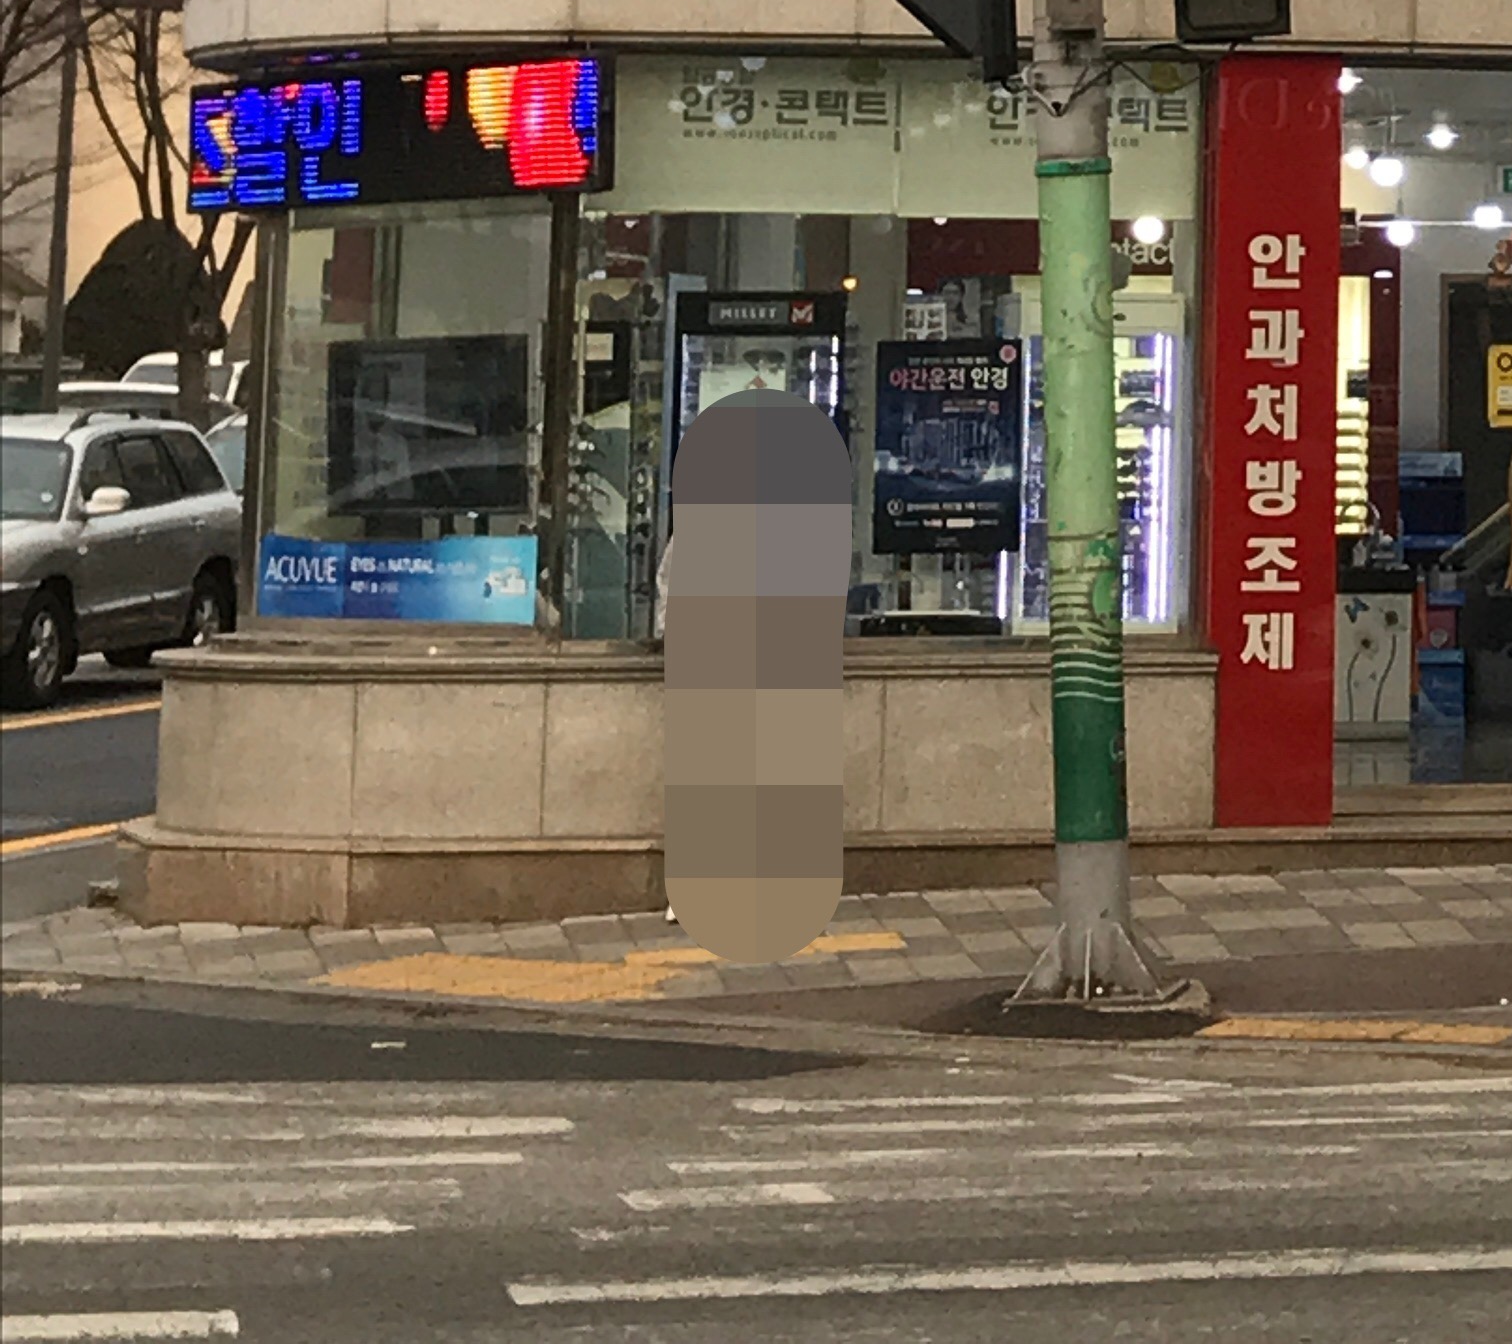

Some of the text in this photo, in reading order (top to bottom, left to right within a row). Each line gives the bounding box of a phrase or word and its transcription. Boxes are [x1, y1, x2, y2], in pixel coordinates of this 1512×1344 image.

[889, 366, 1009, 392] 야간운전 안경
[1240, 233, 1306, 670] 안과처방조제
[264, 555, 338, 585] ACUVUE
